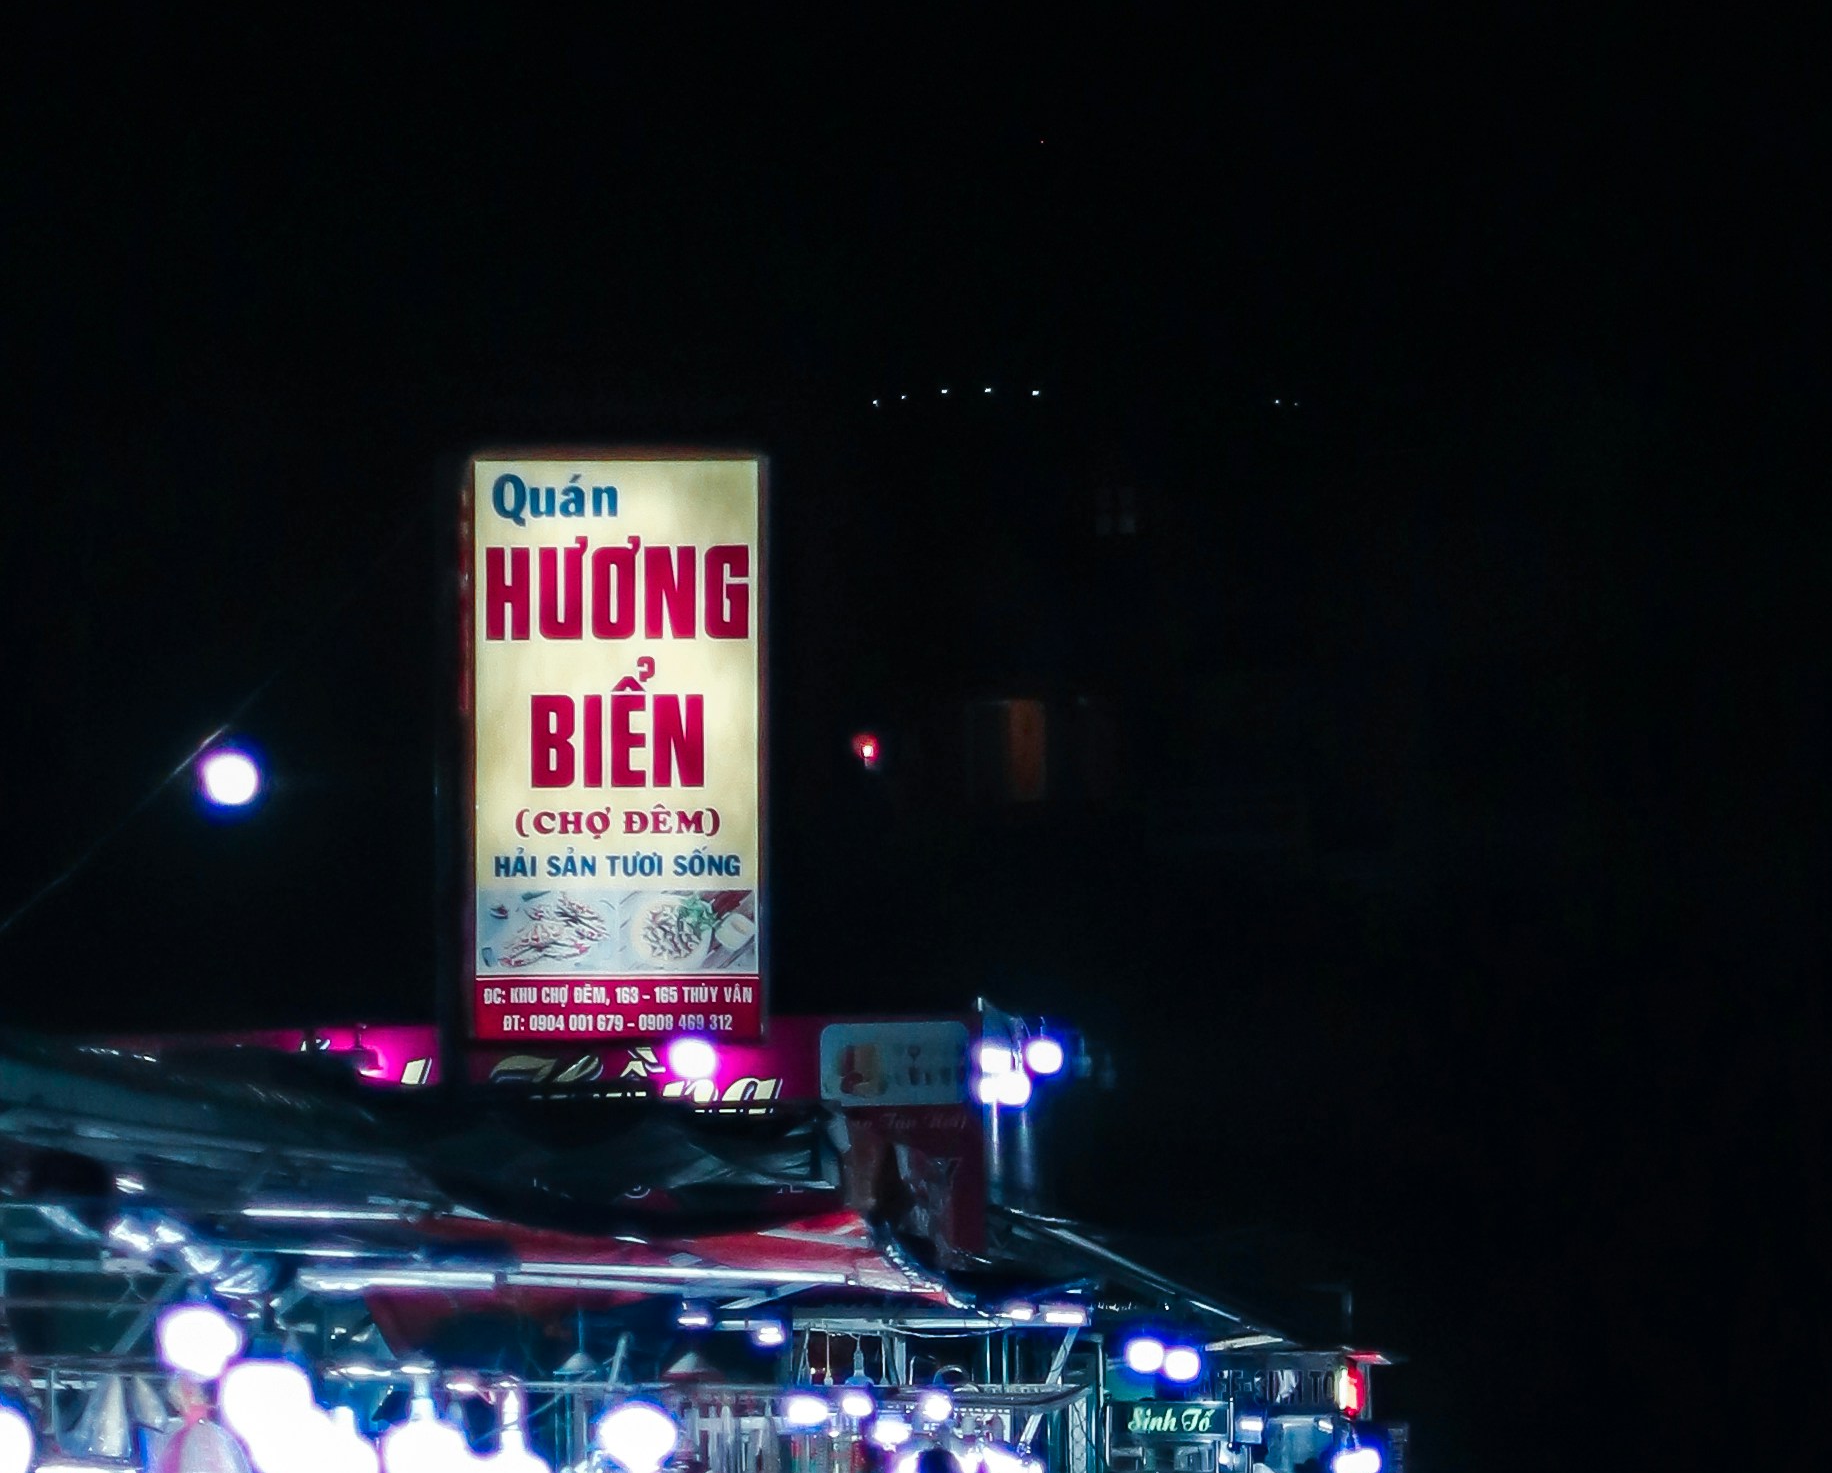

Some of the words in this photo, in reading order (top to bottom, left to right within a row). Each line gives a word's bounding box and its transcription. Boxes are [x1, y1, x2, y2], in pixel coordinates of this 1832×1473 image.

[493, 473, 618, 526] Quán
[485, 536, 749, 640] HƯƠNG
[530, 656, 705, 788] BIỂN
[515, 807, 611, 839] (CHỢ
[624, 804, 721, 836] ĐÊM)
[494, 847, 537, 878] HẢI
[546, 847, 596, 878] SẢN
[607, 851, 664, 878] TƯƠI
[673, 845, 741, 878] SỐNG
[510, 987, 538, 1004] KHU
[541, 984, 569, 1008] CHỢ
[573, 983, 610, 1006] ĐÊM,
[614, 986, 640, 1004] 163
[653, 986, 678, 1004] 165
[723, 983, 753, 1004] VÂN
[529, 1014, 565, 1031] 0904
[568, 1014, 594, 1031] 001
[597, 1014, 624, 1031] 679
[678, 1013, 705, 1031] 469
[709, 1013, 733, 1031] 312
[1127, 1405, 1178, 1433] Sinh
[1182, 1406, 1214, 1433] Tố
